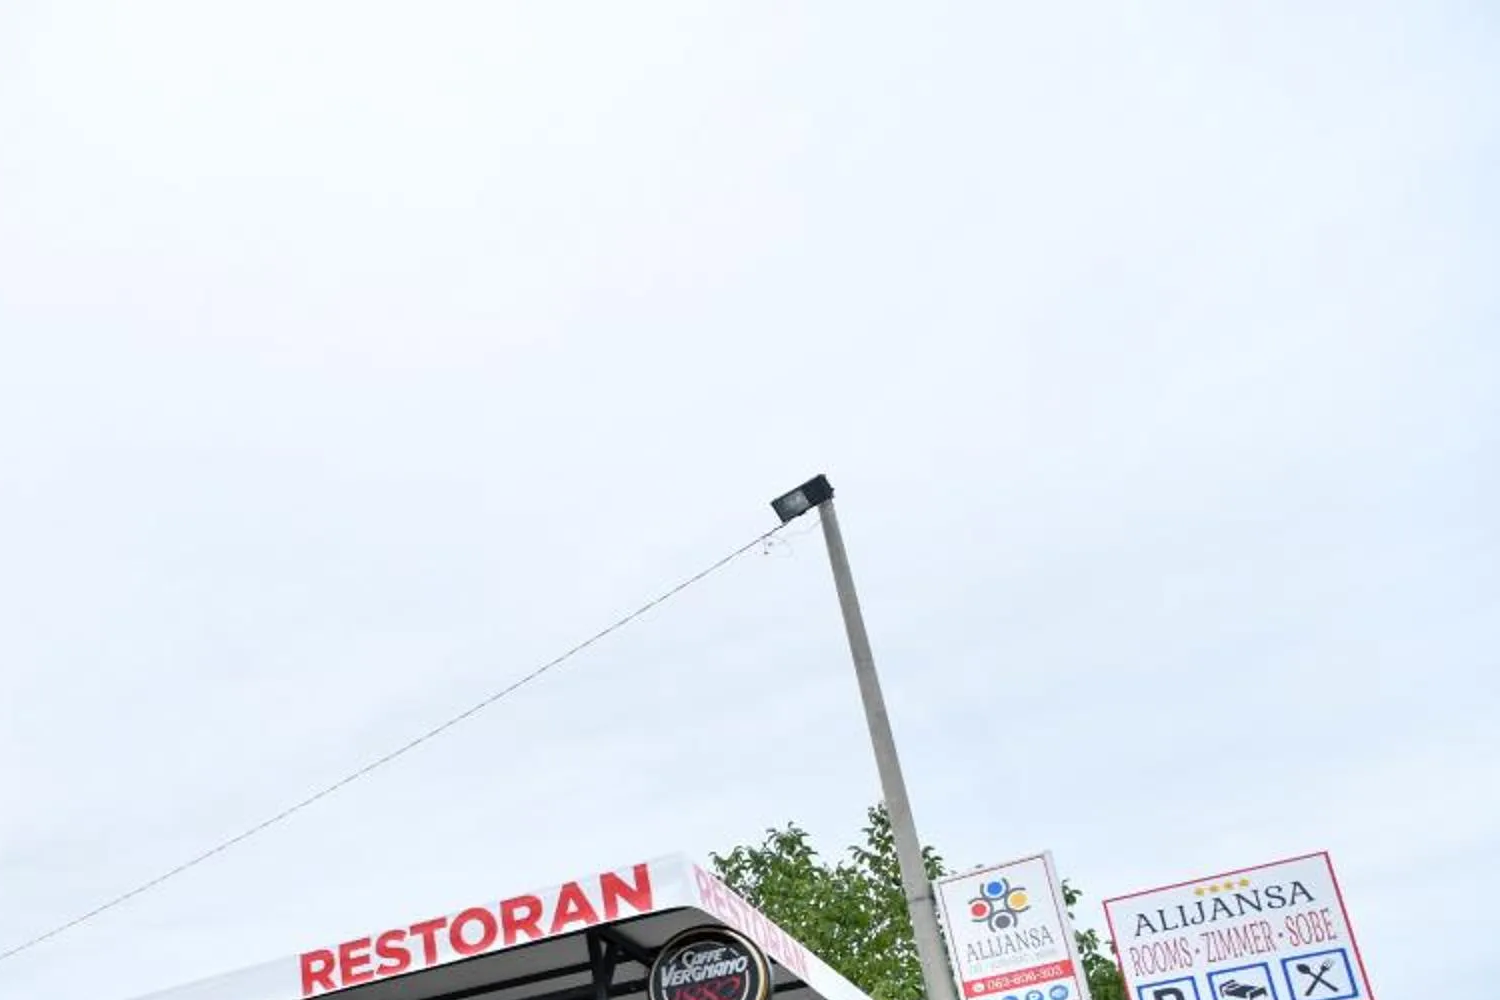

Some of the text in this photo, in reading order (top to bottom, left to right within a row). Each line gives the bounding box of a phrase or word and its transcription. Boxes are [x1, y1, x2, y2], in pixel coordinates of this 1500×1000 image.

[299, 862, 655, 997] RESTORAN
[1133, 880, 1315, 937] ALIJANSA
[967, 925, 1055, 961] ALIJANSA
[1129, 907, 1338, 977] ROOMS ZIMMER SOBE
